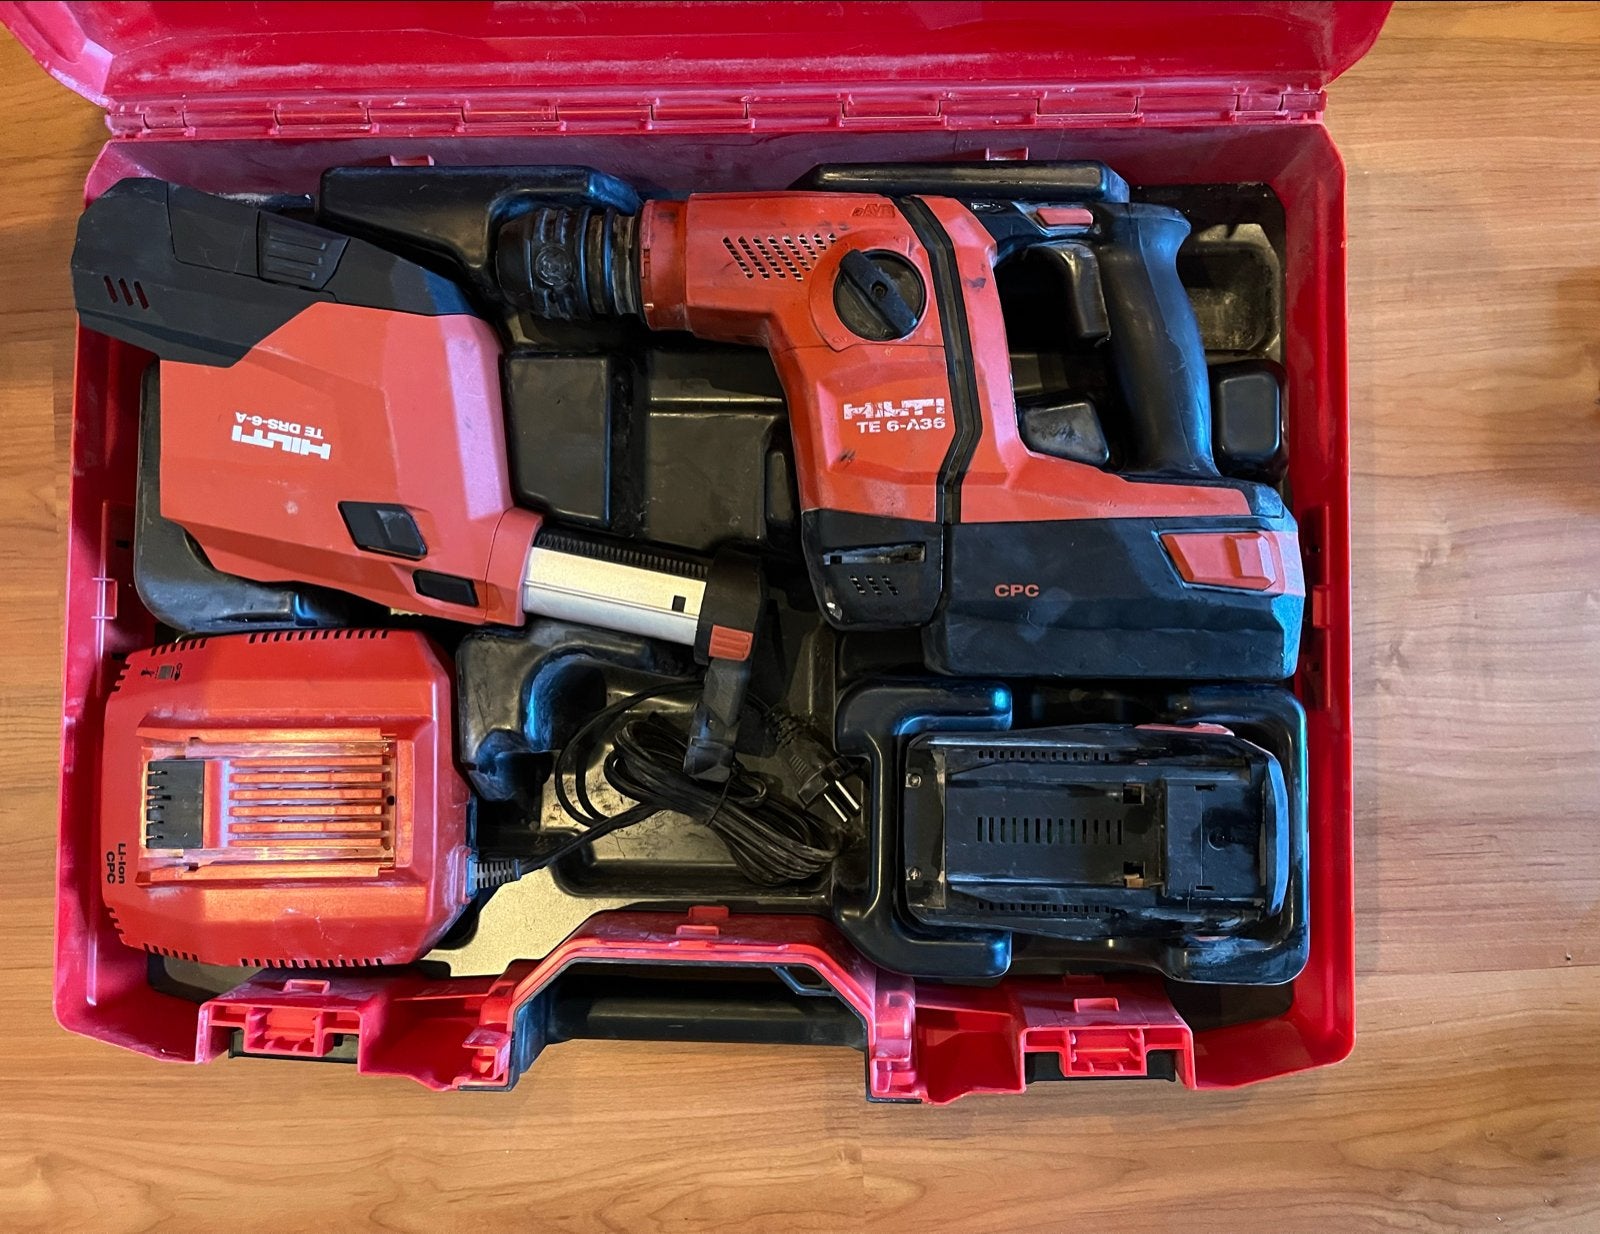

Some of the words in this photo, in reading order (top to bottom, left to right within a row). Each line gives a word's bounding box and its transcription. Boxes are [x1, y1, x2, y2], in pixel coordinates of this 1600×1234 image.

[843, 398, 945, 420] HILTI
[235, 411, 302, 435] DRS-6-A
[303, 426, 324, 440] TE
[856, 420, 881, 434] TE
[886, 417, 946, 432] 6-A36
[231, 424, 332, 460] HILTI
[994, 583, 1040, 598] CPC
[106, 851, 116, 884] CPC
[118, 843, 127, 884] Li-Ion
